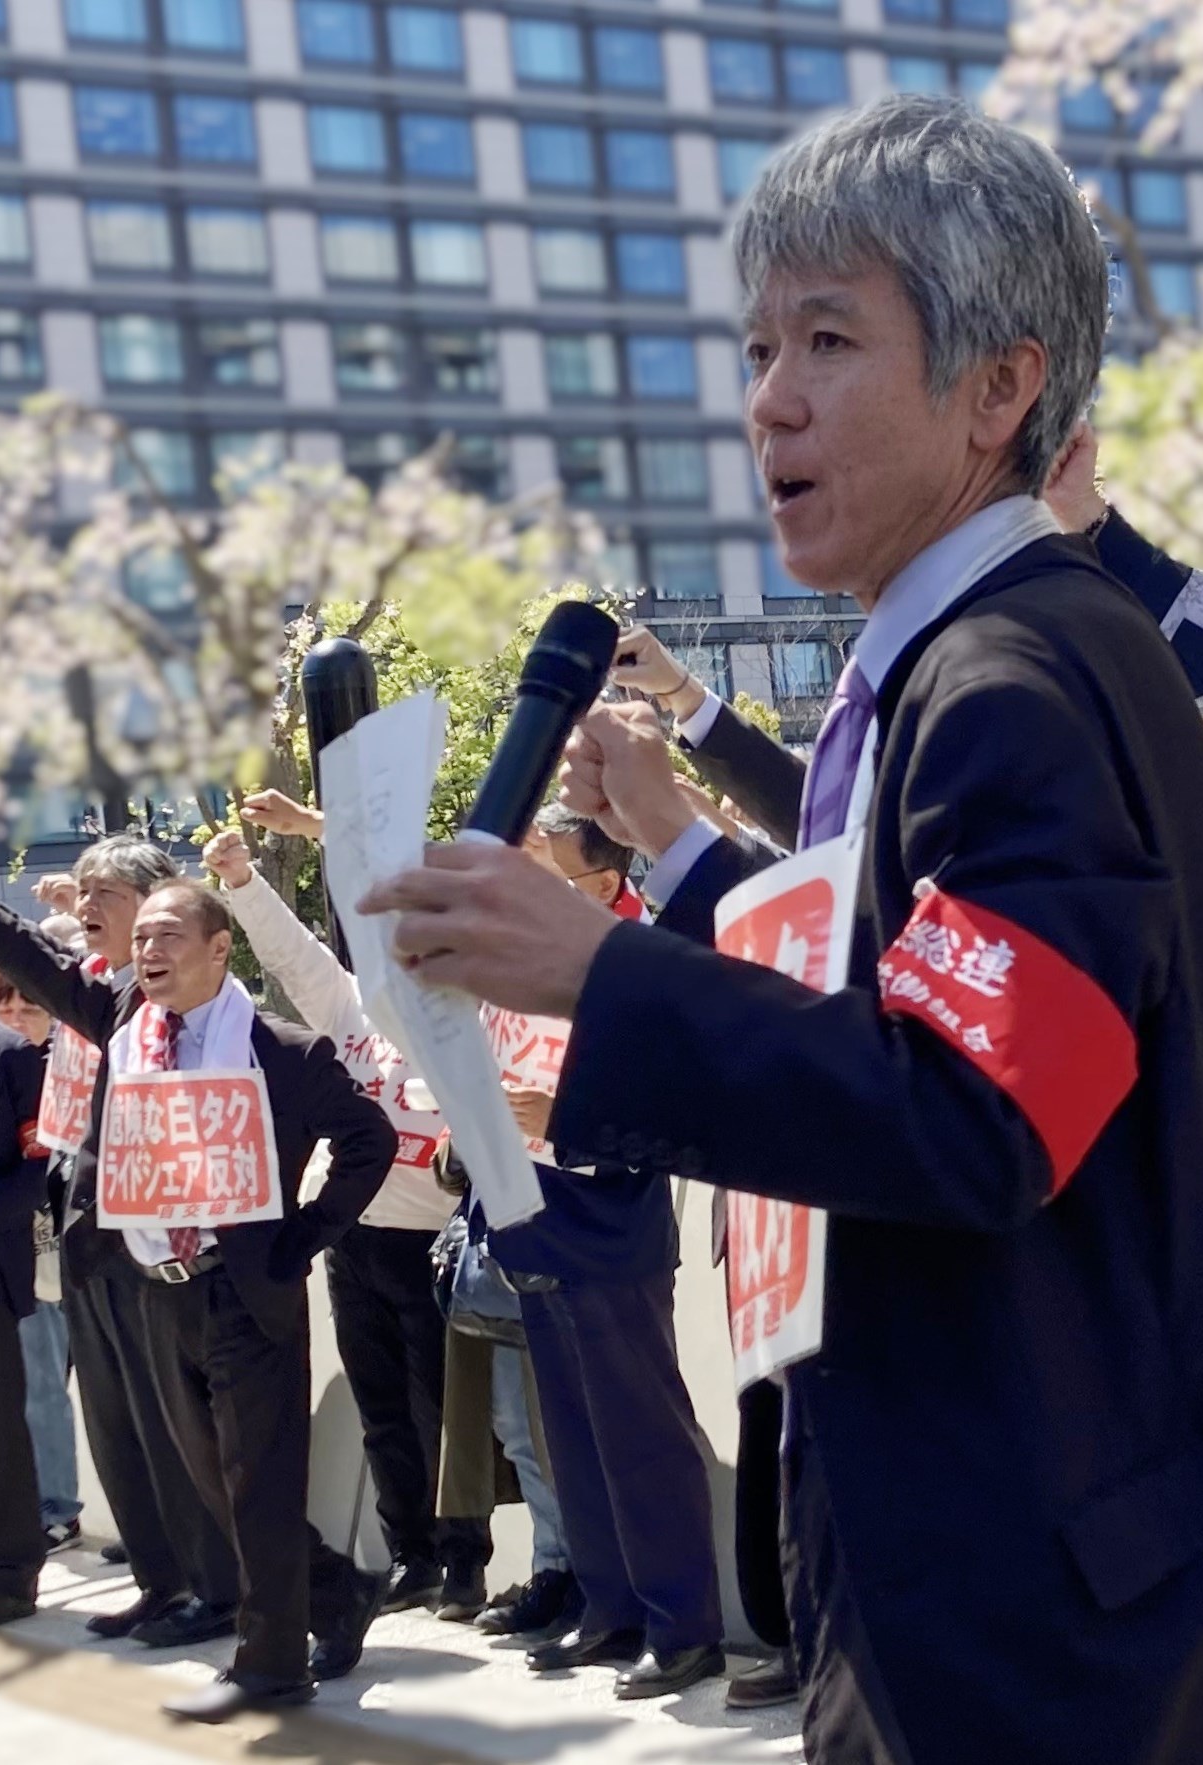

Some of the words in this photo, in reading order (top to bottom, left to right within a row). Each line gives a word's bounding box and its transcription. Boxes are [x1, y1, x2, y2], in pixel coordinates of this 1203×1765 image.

[107, 1088, 251, 1146] 危険な白タク
[105, 1141, 258, 1202] ライドシェア反対
